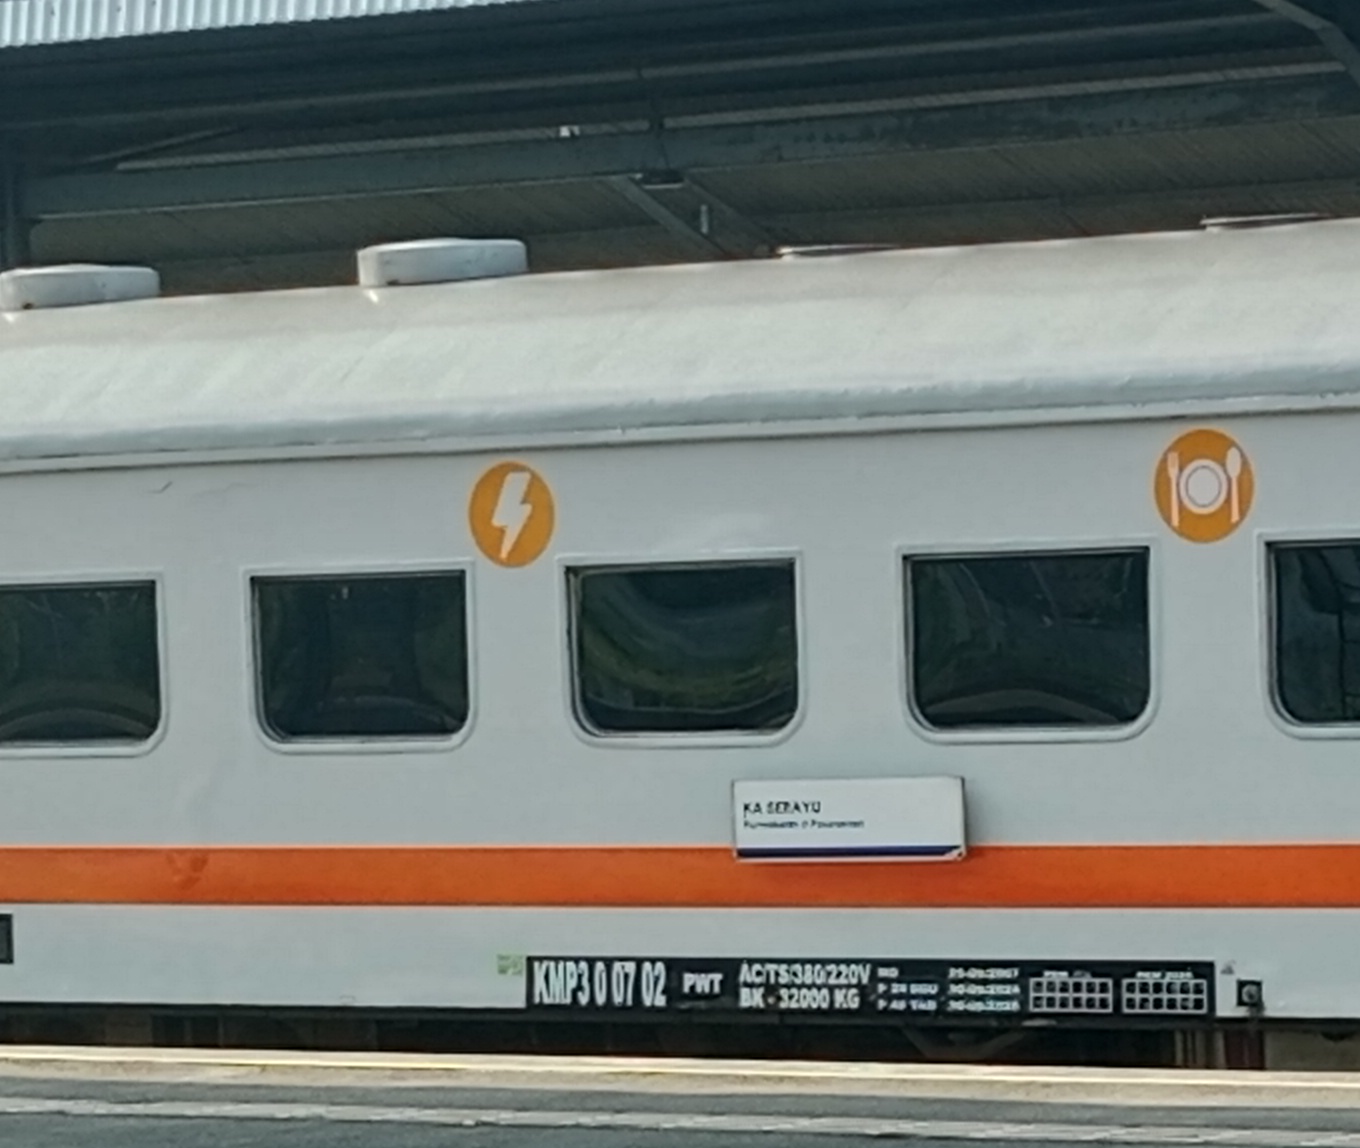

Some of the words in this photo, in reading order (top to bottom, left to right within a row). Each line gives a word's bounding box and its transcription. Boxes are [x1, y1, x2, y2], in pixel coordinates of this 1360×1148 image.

[533, 961, 589, 1006] KMP3
[594, 961, 607, 1006] 0
[612, 961, 636, 1006] 07
[641, 961, 666, 1007] 02
[682, 973, 723, 994] PWT
[779, 987, 830, 1008] 32000
[834, 987, 860, 1008] KG
